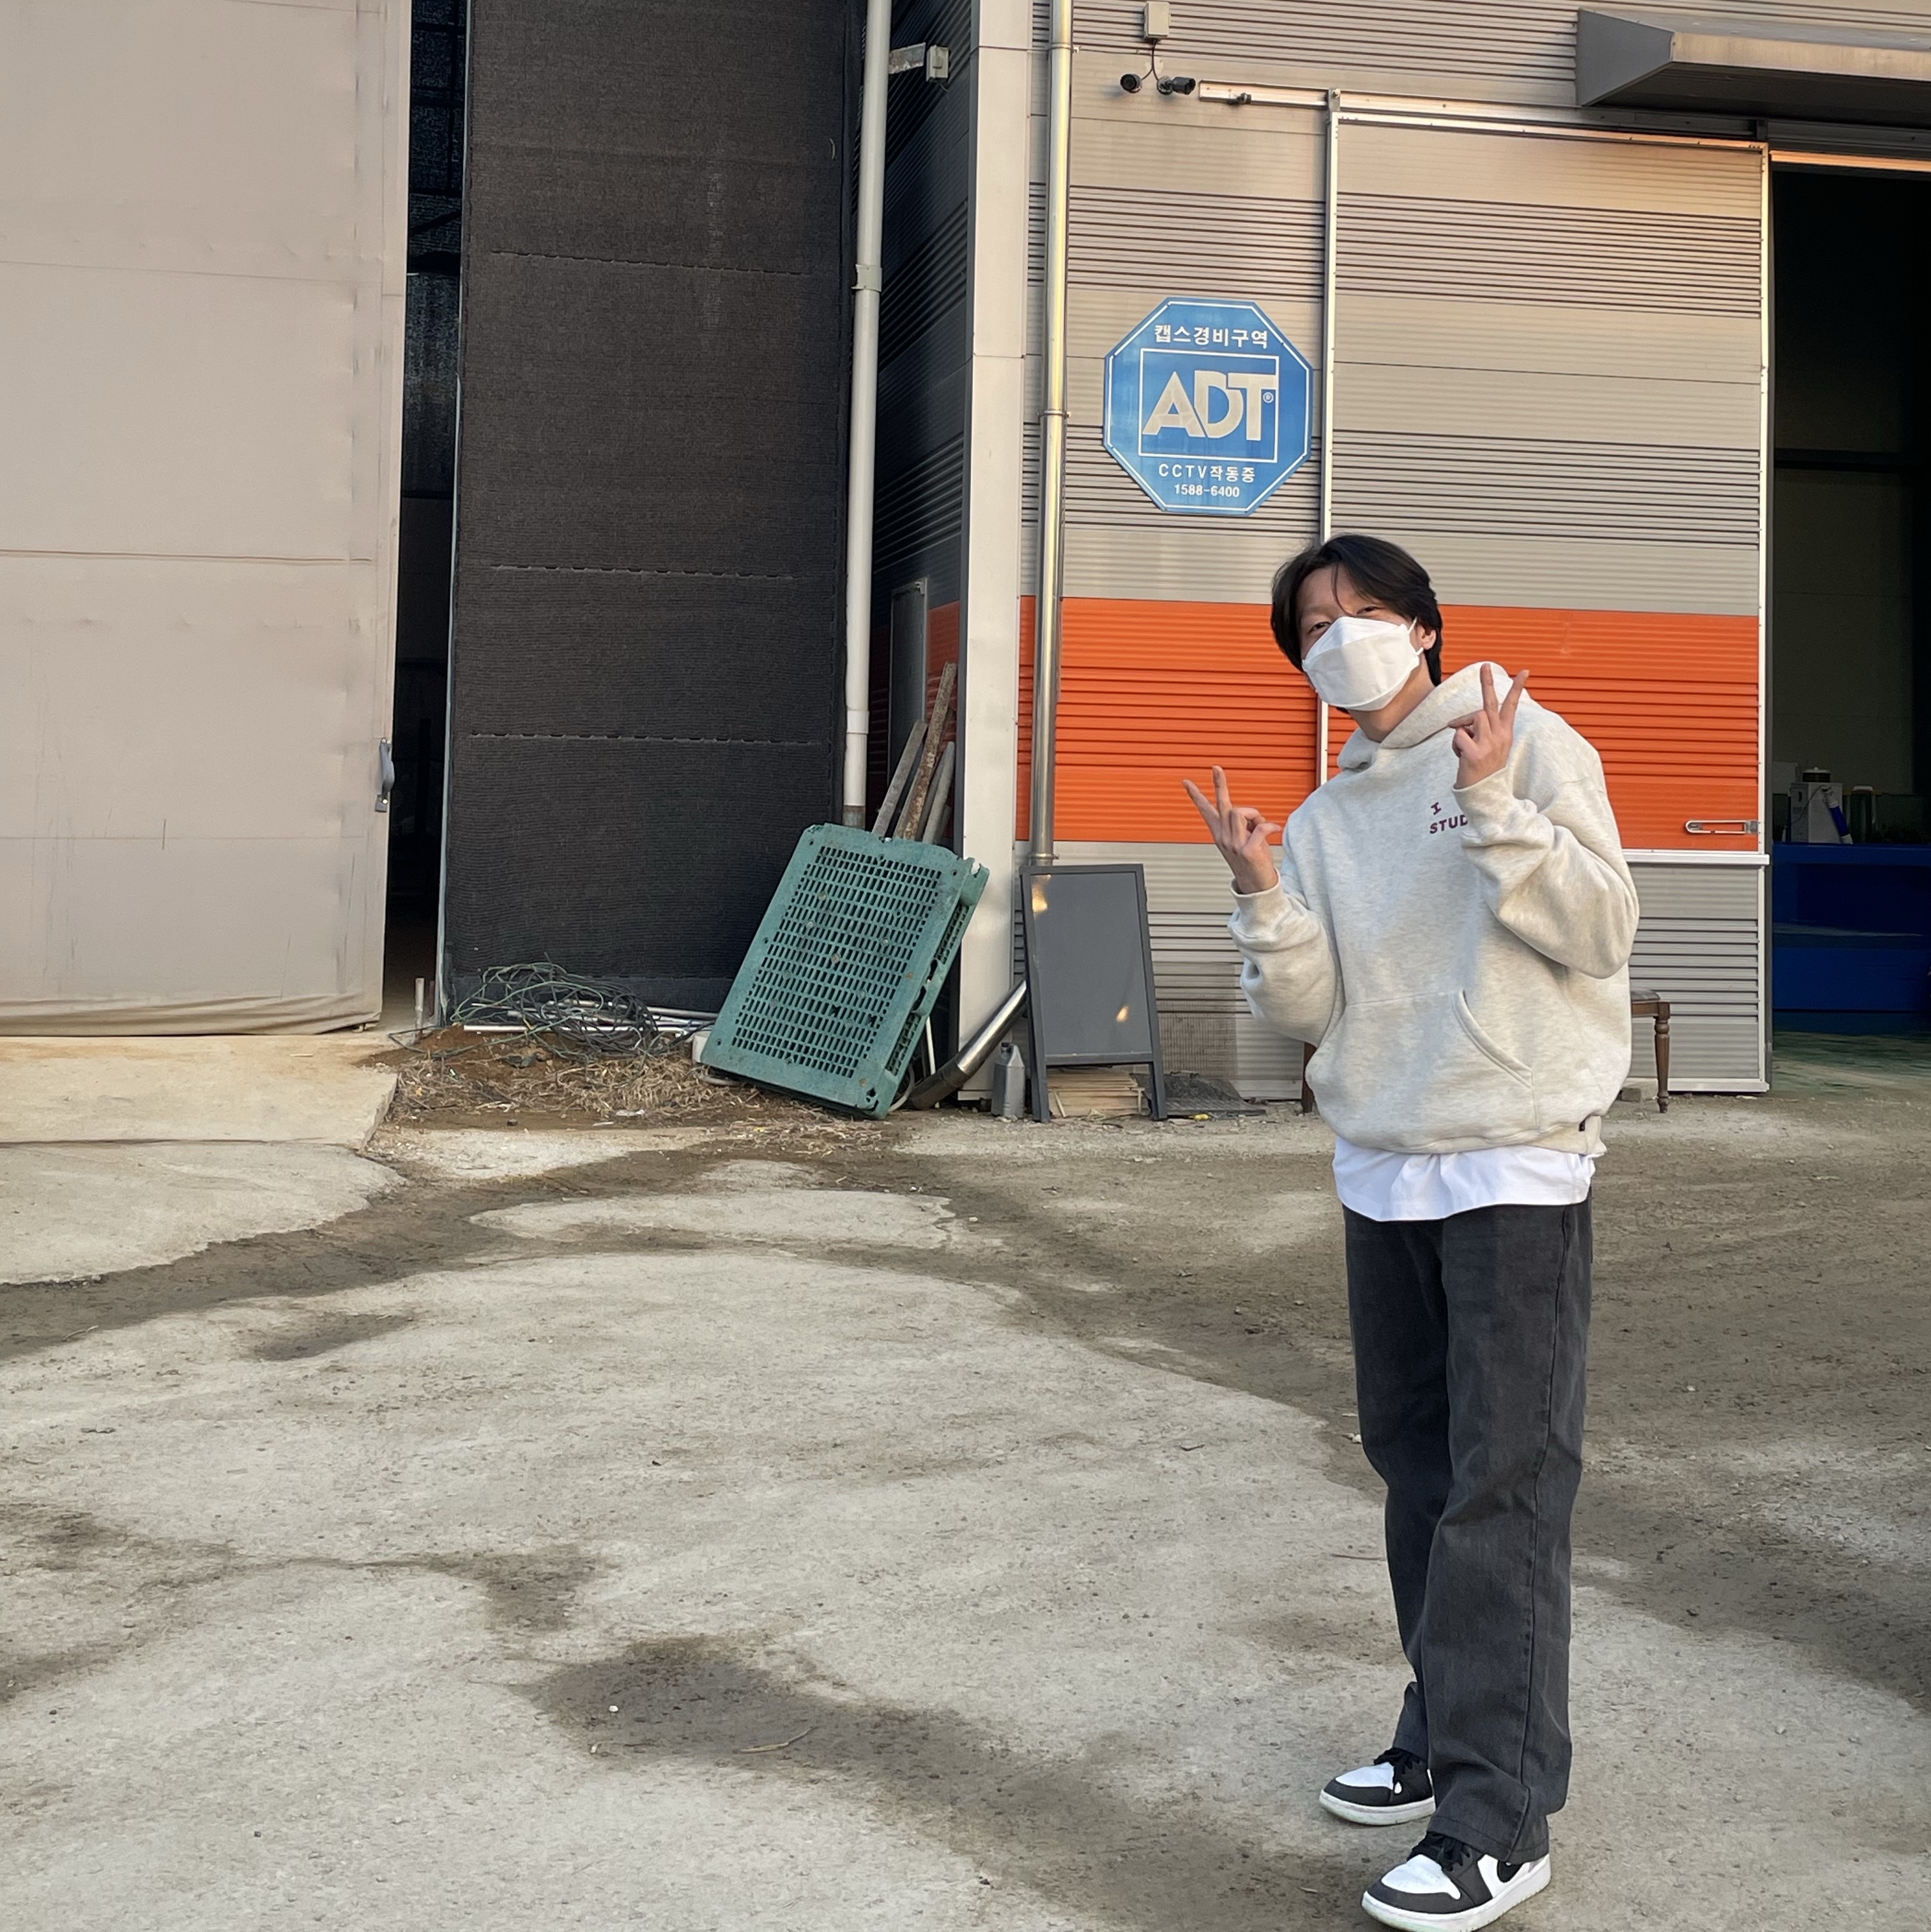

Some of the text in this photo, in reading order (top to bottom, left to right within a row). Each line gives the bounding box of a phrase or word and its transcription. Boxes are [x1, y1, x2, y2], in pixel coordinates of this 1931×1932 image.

[1154, 325, 1267, 349] 캡스경비구역
[1142, 370, 1277, 441] ADT
[1159, 464, 1255, 483] CCTV작동중
[1174, 484, 1240, 498] 1588-6400
